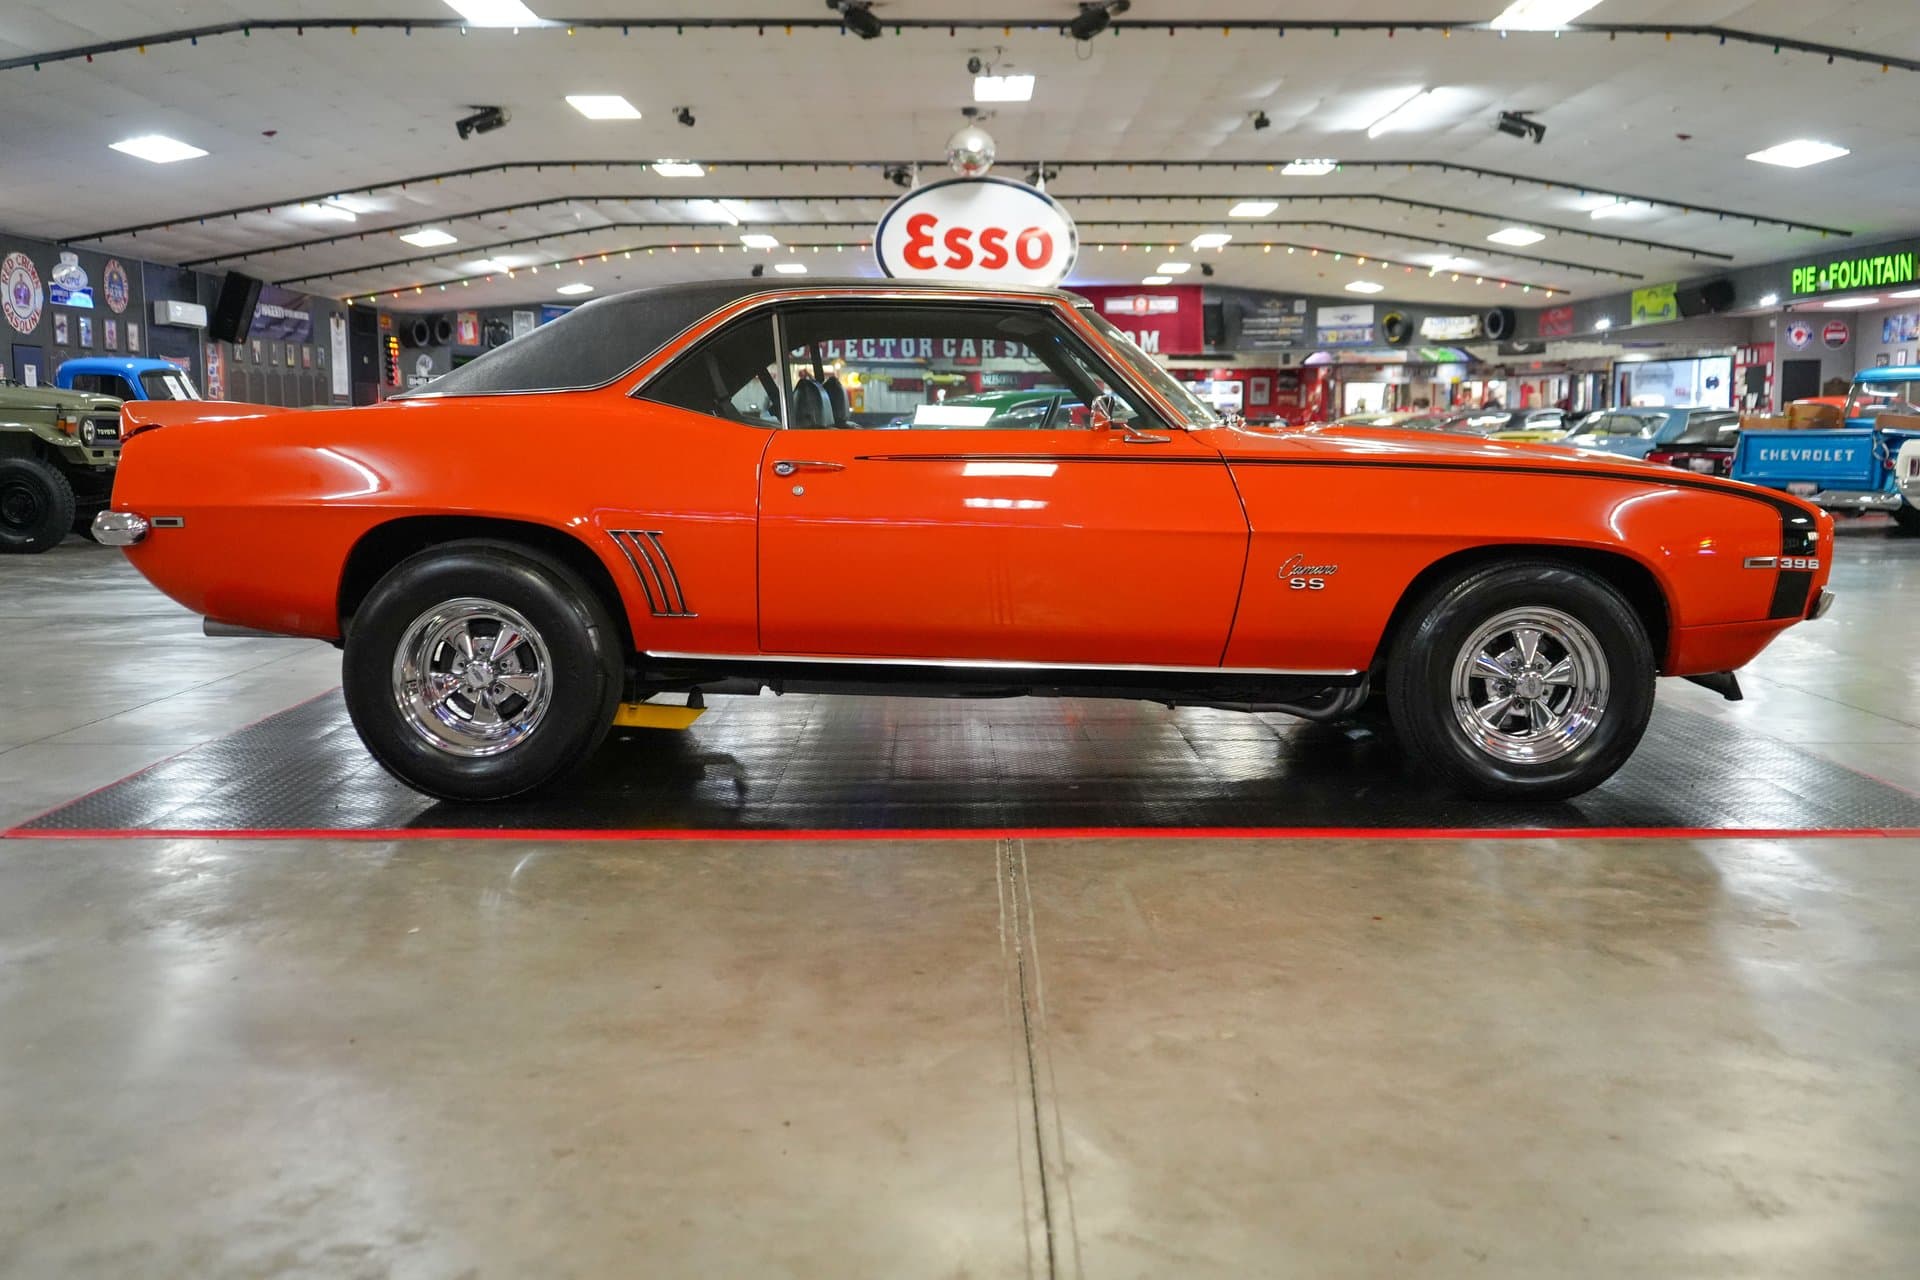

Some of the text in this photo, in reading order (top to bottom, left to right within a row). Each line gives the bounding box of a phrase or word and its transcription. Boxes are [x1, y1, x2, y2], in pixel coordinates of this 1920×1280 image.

[2, 258, 14, 285] RED
[1792, 252, 1912, 294] PIE FOUNTAIN
[943, 338, 995, 358] CAR
[1759, 448, 1855, 463] CHEVROLET
[1278, 553, 1338, 579] Camaro
[1780, 557, 1820, 570] 396
[1290, 577, 1325, 590] SS
